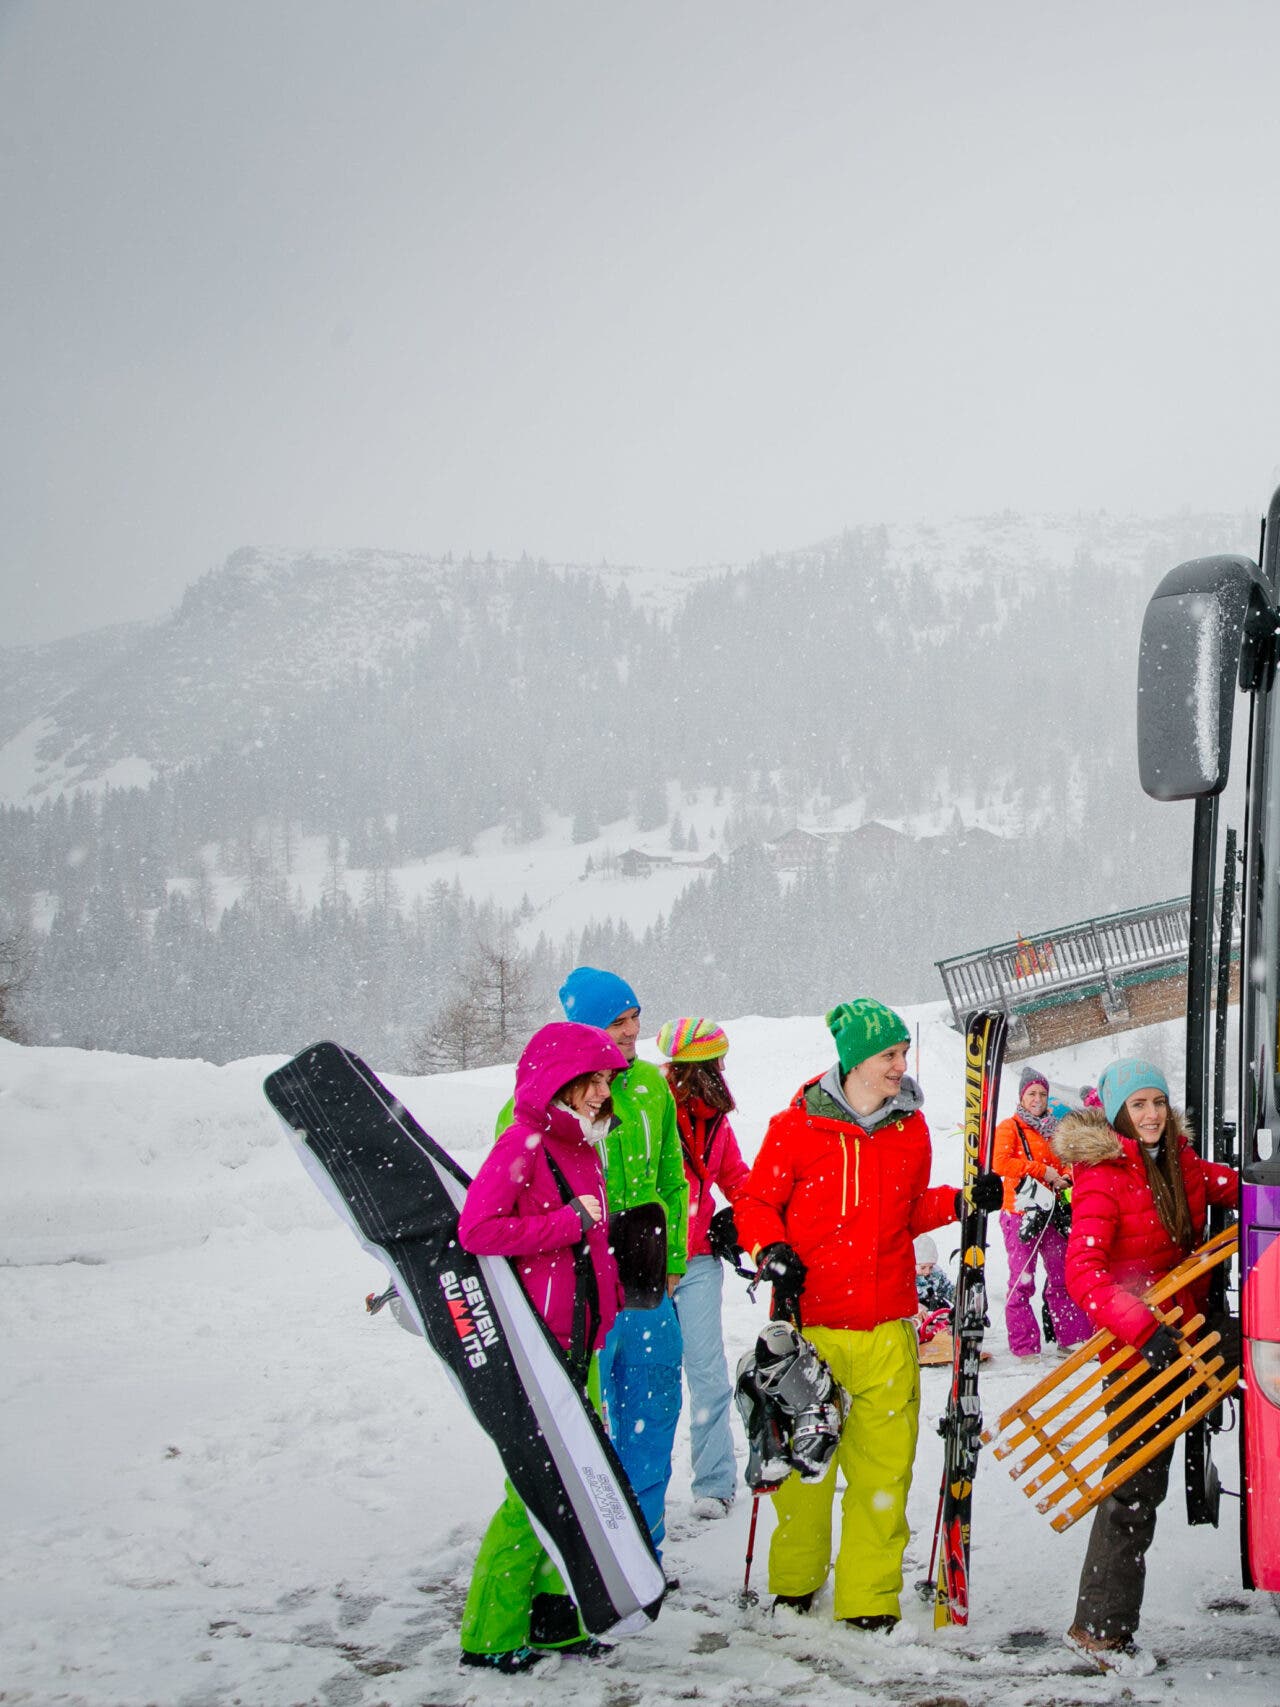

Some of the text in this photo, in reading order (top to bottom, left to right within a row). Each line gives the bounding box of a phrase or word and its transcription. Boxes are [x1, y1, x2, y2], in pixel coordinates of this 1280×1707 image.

[440, 1270, 487, 1368] SUMMITS
[461, 1275, 499, 1348] SEVEN
[597, 1473, 627, 1520] SEVEN
